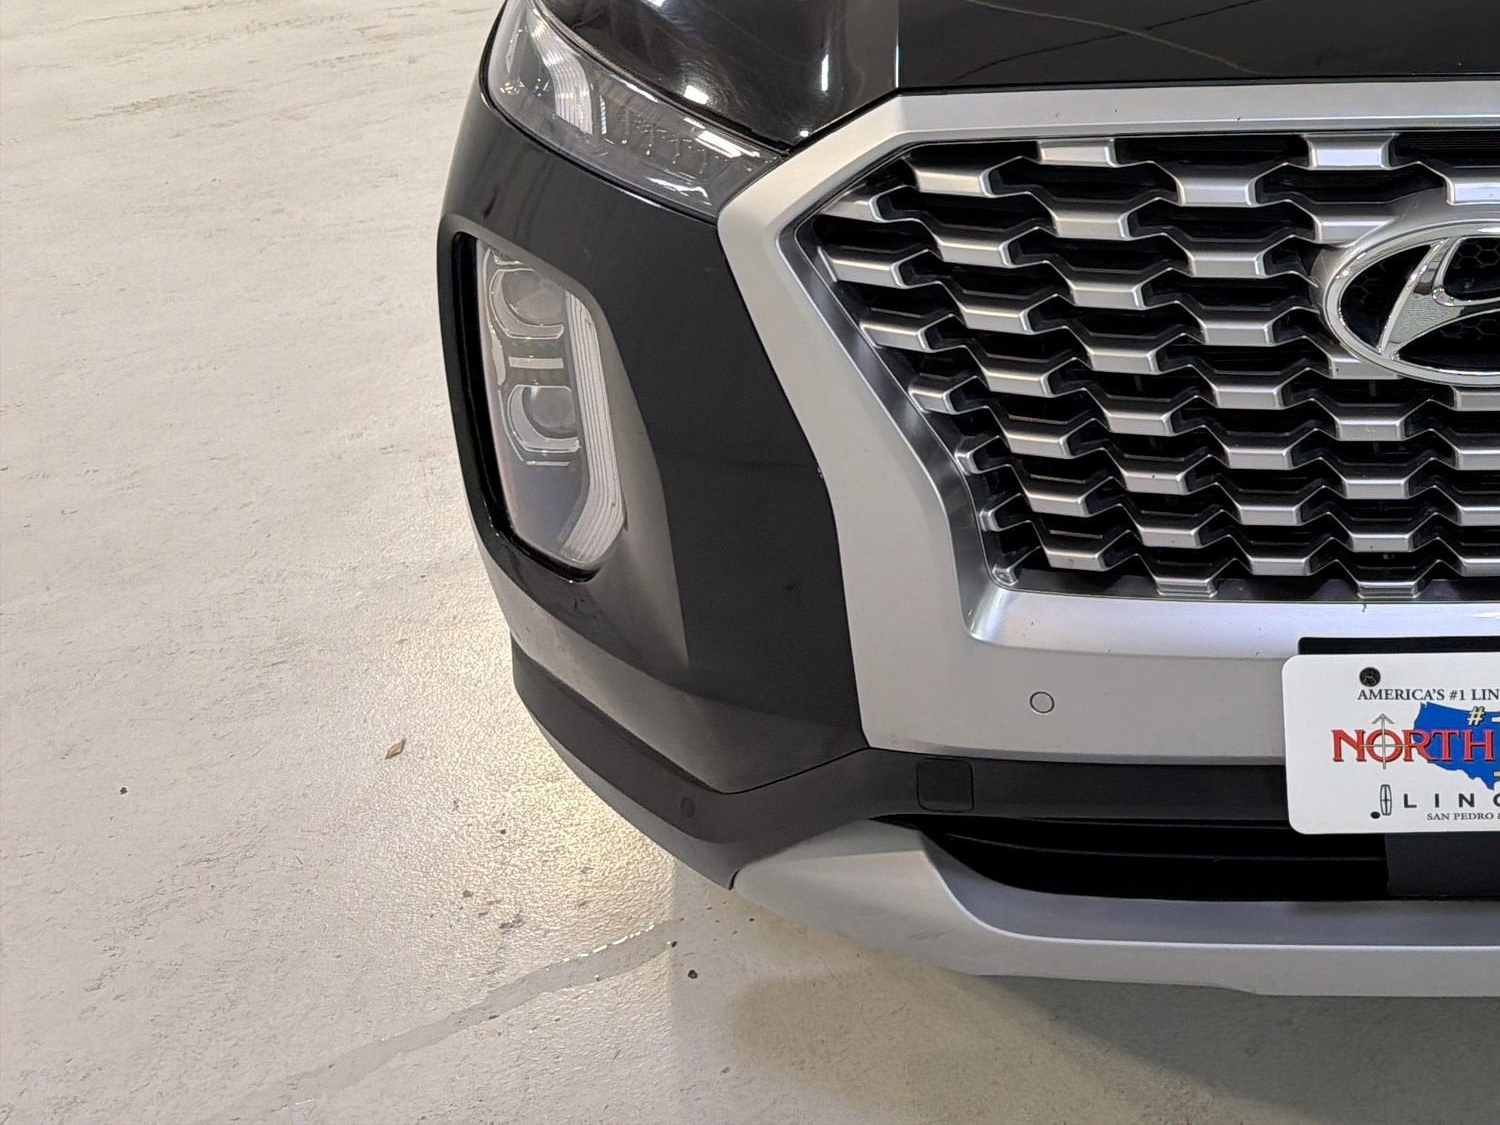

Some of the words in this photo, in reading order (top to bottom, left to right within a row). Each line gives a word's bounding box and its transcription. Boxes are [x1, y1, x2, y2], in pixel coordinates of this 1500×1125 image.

[1357, 688, 1445, 701] AMERICA'S
[1449, 689, 1466, 701] #1
[1331, 729, 1495, 763] NORTH
[1426, 812, 1450, 821] SAN
[1453, 812, 1494, 821] PEDRO
